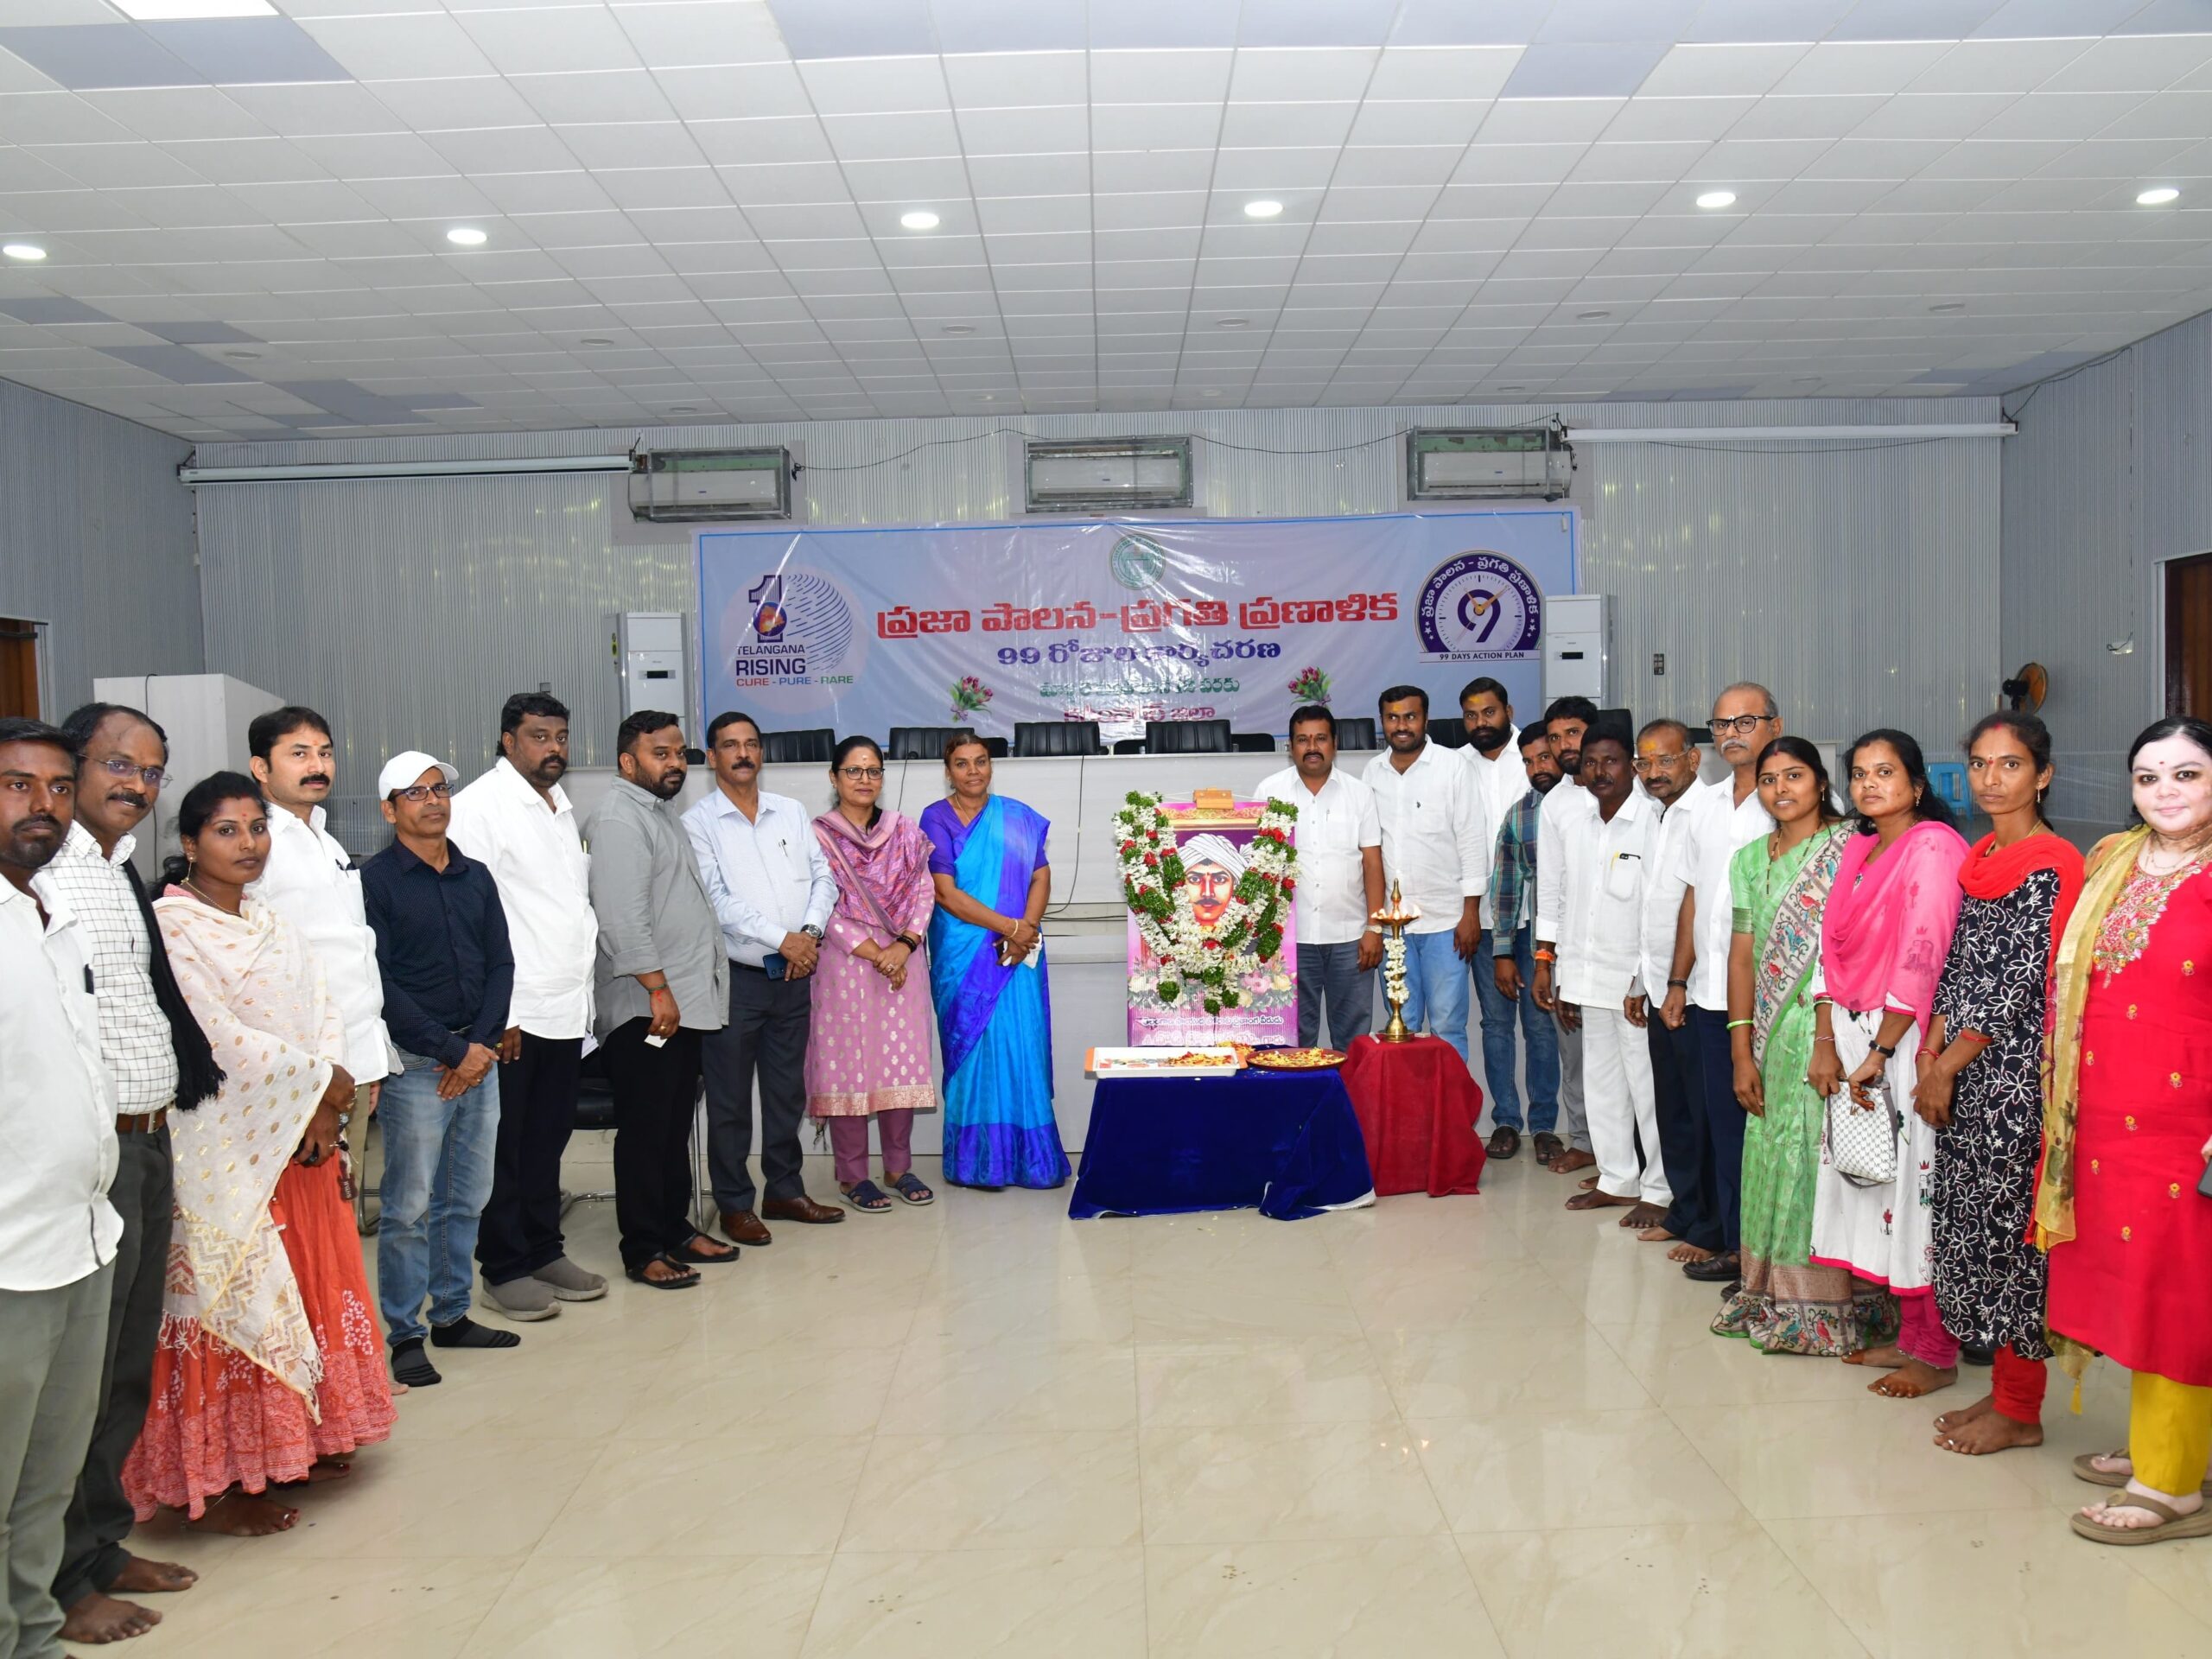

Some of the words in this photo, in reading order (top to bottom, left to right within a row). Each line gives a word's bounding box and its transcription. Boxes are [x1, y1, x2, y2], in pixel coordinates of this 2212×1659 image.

[877, 606, 971, 639] ప్రజా
[1239, 593, 1398, 630] ప్రణాళిక
[736, 645, 805, 655] TELANGANA
[997, 646, 1040, 664] 99
[736, 658, 806, 676] RISING
[736, 677, 770, 687] CURE
[779, 677, 811, 685] PURE
[821, 676, 854, 684] RARE
